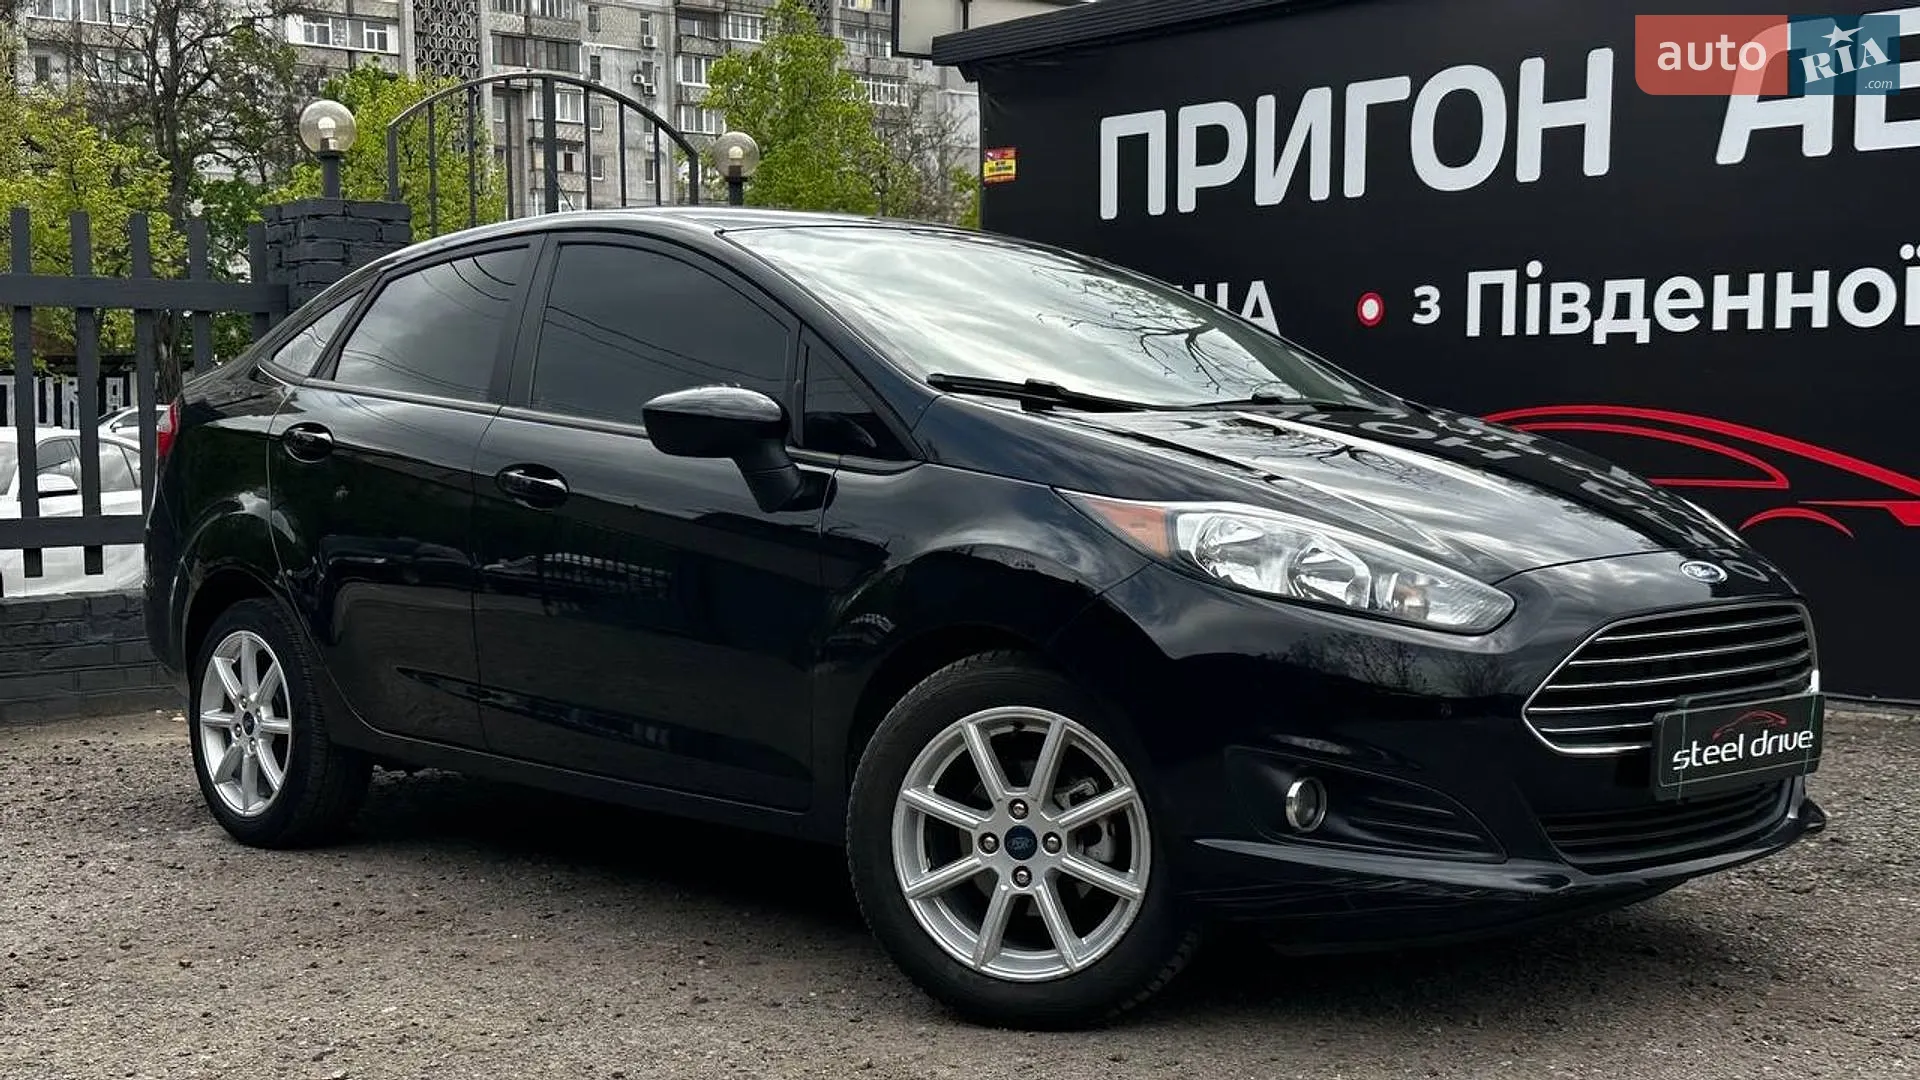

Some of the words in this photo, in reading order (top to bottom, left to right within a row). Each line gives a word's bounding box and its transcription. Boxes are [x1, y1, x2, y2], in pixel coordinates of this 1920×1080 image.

[1099, 47, 1614, 220] ПРИГОН
[1672, 733, 1745, 771] steel
[1750, 729, 1814, 757] drive
